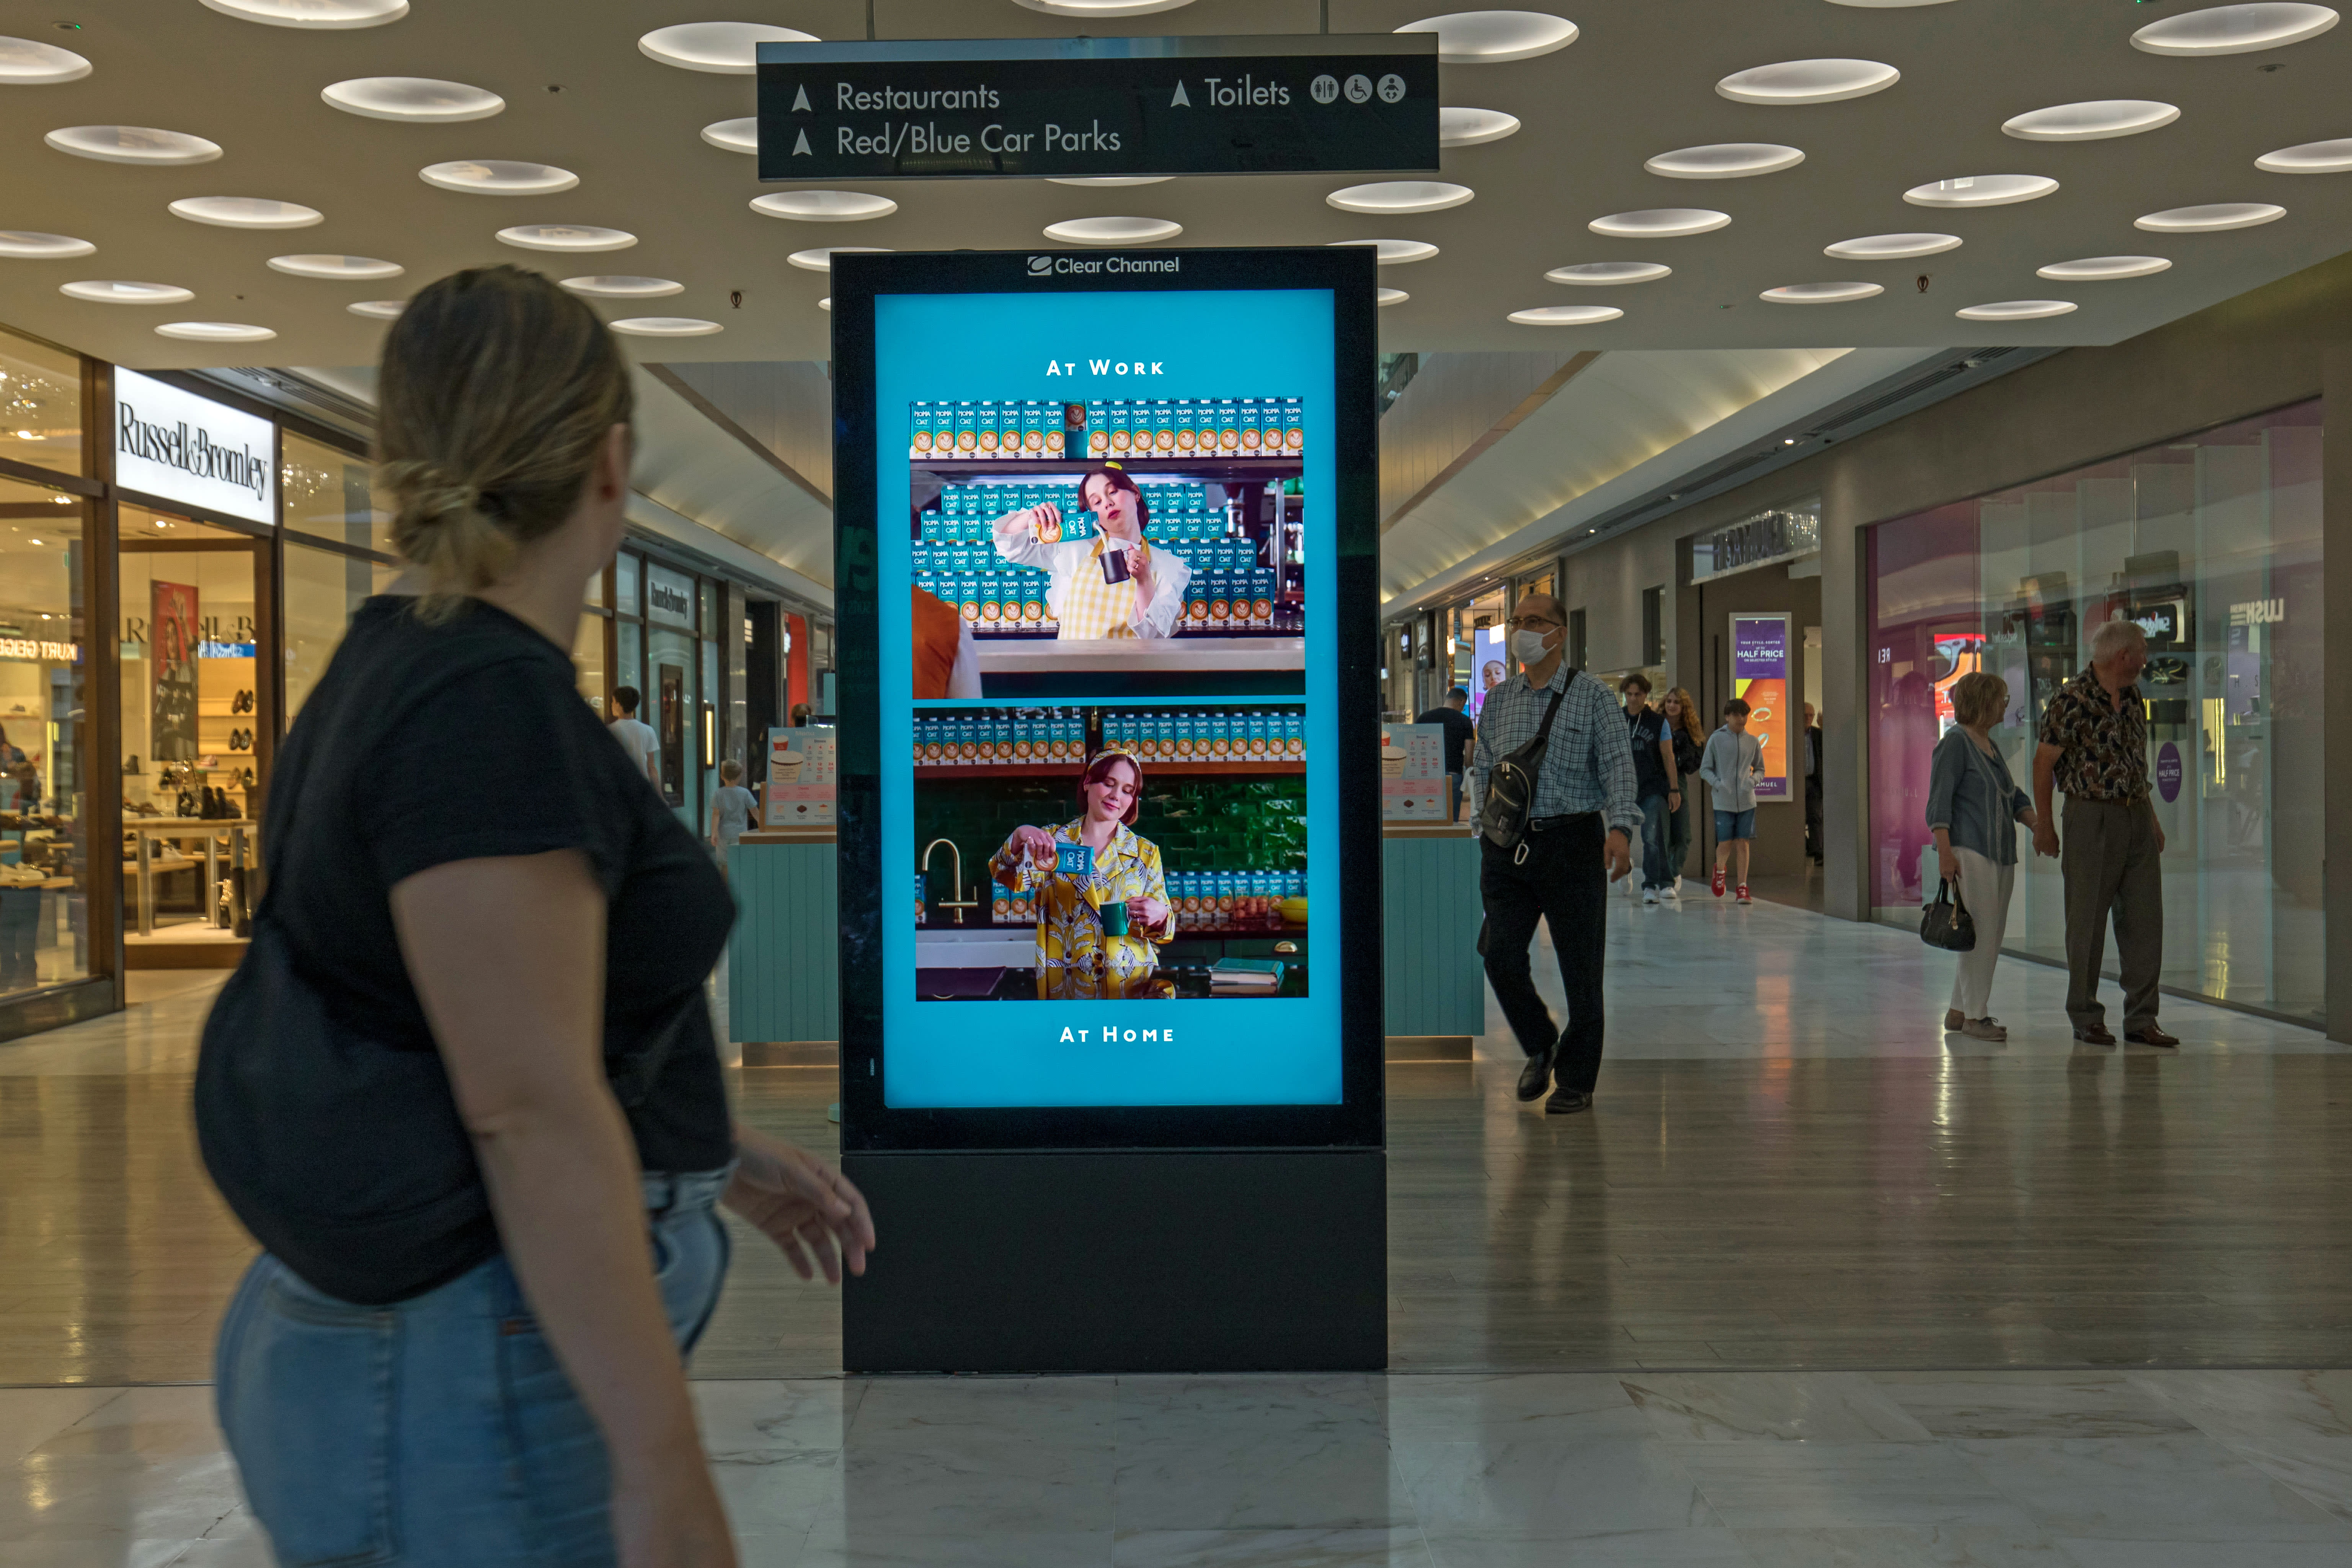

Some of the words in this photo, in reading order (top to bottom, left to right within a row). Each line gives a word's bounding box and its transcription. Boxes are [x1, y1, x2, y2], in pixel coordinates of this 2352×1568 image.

[838, 83, 999, 109] Restaurants
[1205, 74, 1289, 106] Toilets
[839, 122, 970, 157] Red/Blue
[981, 125, 1034, 152] Car
[1046, 120, 1120, 151] Parks
[1056, 258, 1102, 273] Clear
[1107, 257, 1178, 272] Channel
[1760, 650, 1784, 658] PRICE
[2169, 769, 2180, 777] PRICE
